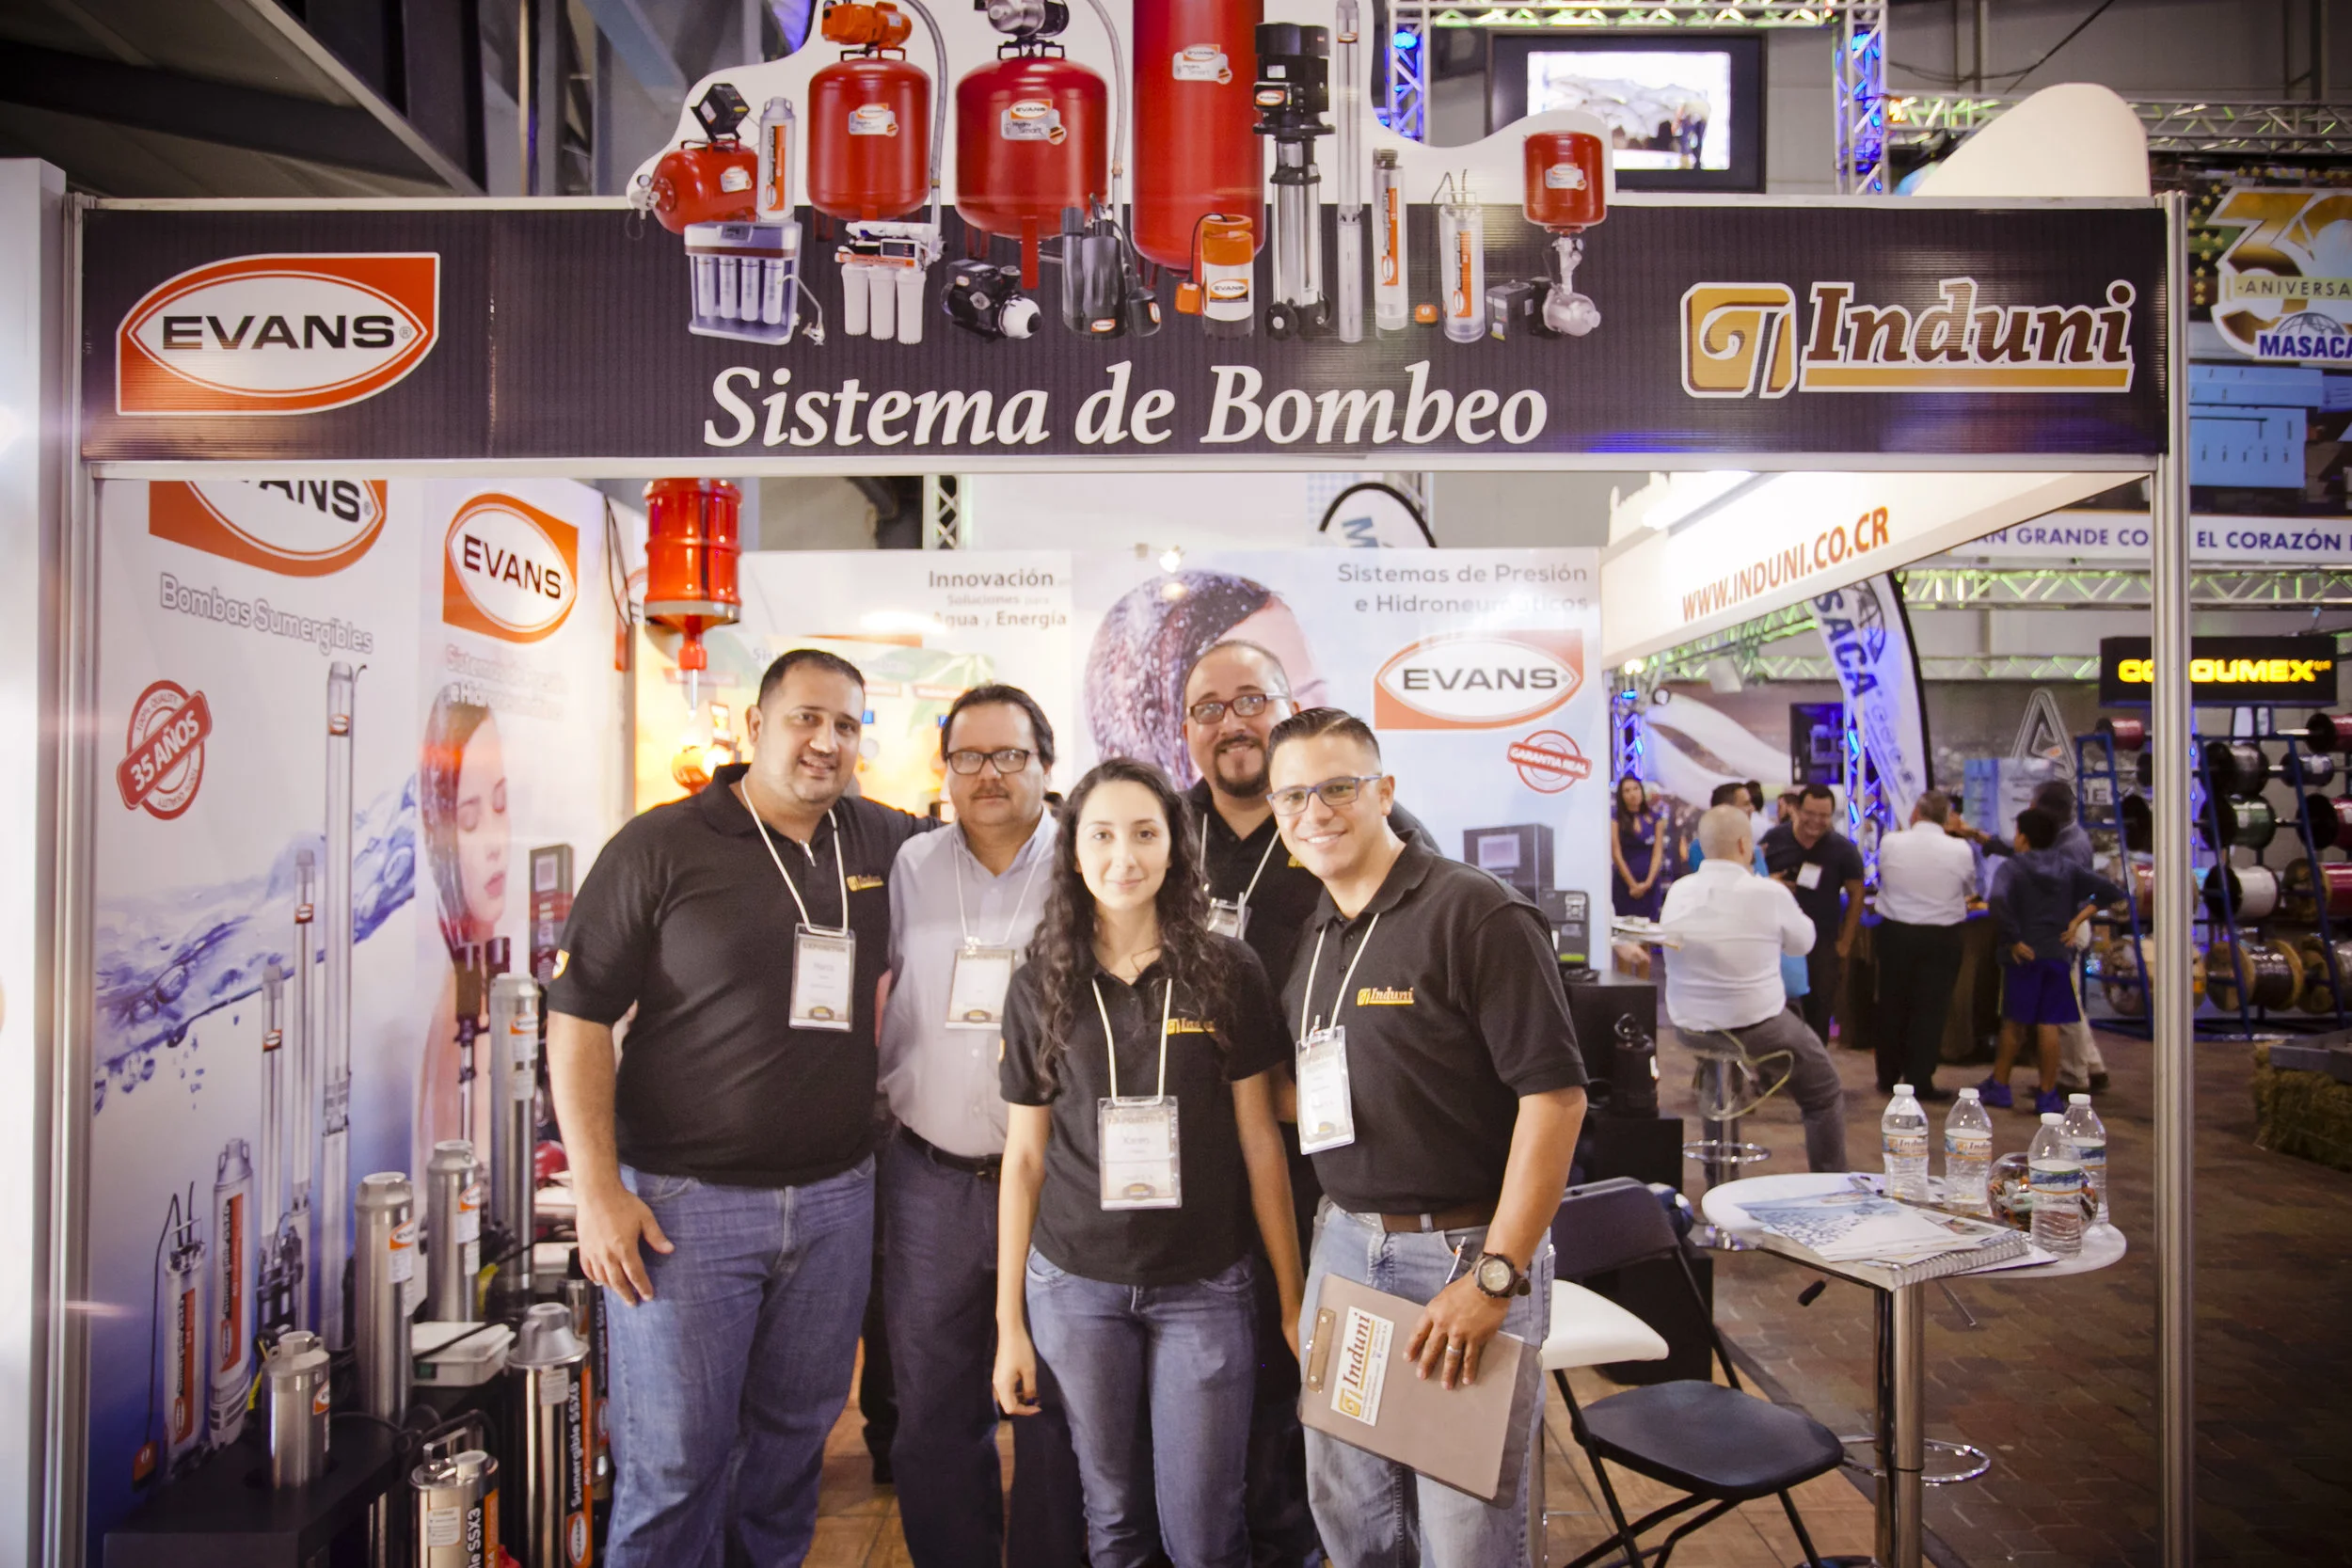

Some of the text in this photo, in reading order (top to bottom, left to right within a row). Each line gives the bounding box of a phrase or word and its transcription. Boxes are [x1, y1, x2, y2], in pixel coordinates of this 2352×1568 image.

[163, 315, 395, 351] EVANS
[1804, 277, 2137, 365] Induni
[704, 360, 1548, 448] Sistema de Bombeo
[2017, 528, 2108, 546] GRANDE
[2118, 529, 2150, 546] CO
[2198, 531, 2218, 548] EL
[2226, 529, 2342, 551] CORAZÓN
[463, 533, 563, 601] EVANS
[929, 568, 1054, 588] Innovación
[1338, 563, 1587, 582] Sistemas de Presión
[1682, 506, 1890, 622] WWW.INDUNI.CO.CR
[159, 571, 373, 656] Bombas Sumergibles
[946, 594, 1020, 607] Soluciones
[1355, 599, 1368, 612] e
[996, 610, 1066, 630] Energía
[1403, 668, 1557, 690] EVANS
[2119, 657, 2315, 683] CODUMEX
[130, 710, 199, 792] 35 AÑOS
[1371, 986, 1414, 1001] Induni
[1343, 1311, 1371, 1388] Induni
[568, 1380, 583, 1509] Sumergible SSX6
[467, 1507, 482, 1552] SSX3
